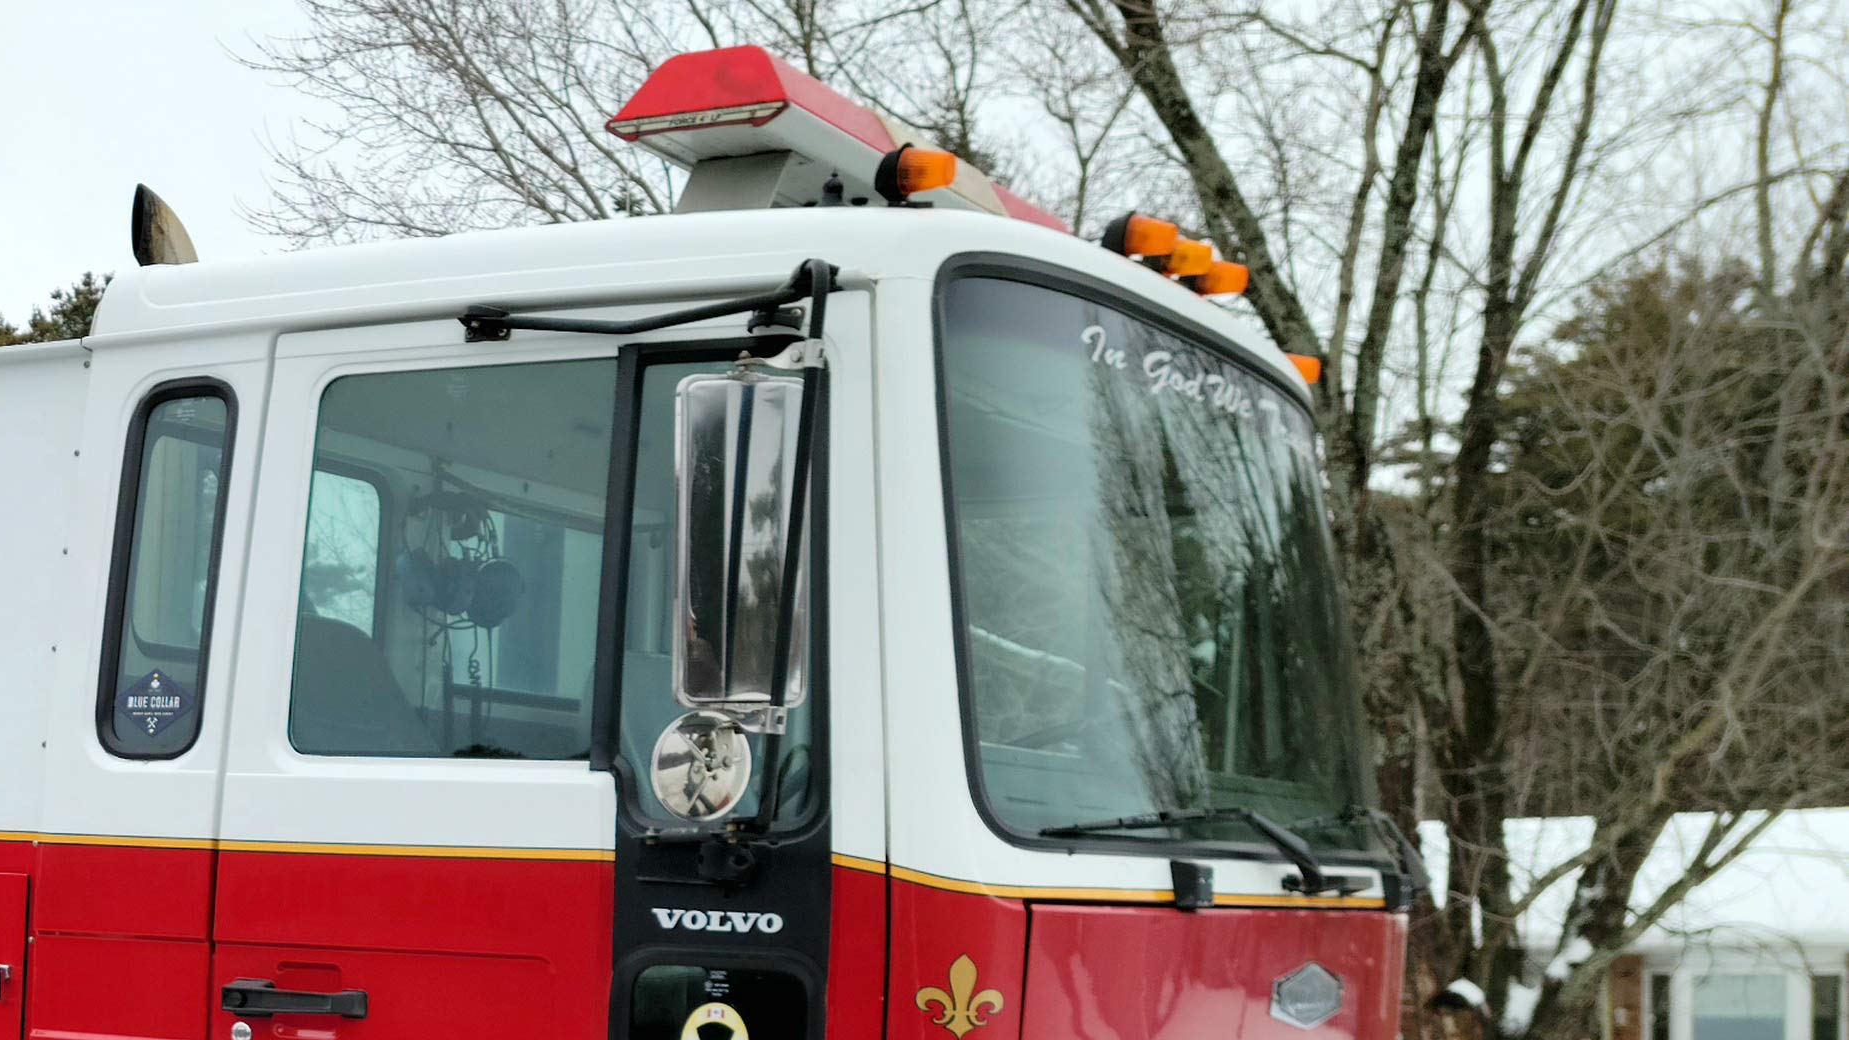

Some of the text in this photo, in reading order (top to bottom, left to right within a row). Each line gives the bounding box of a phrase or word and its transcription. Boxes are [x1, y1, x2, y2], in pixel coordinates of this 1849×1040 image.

[1080, 324, 1254, 418] In God We
[127, 696, 181, 709] BLUE COLLAR
[650, 907, 784, 934] VOLVO
